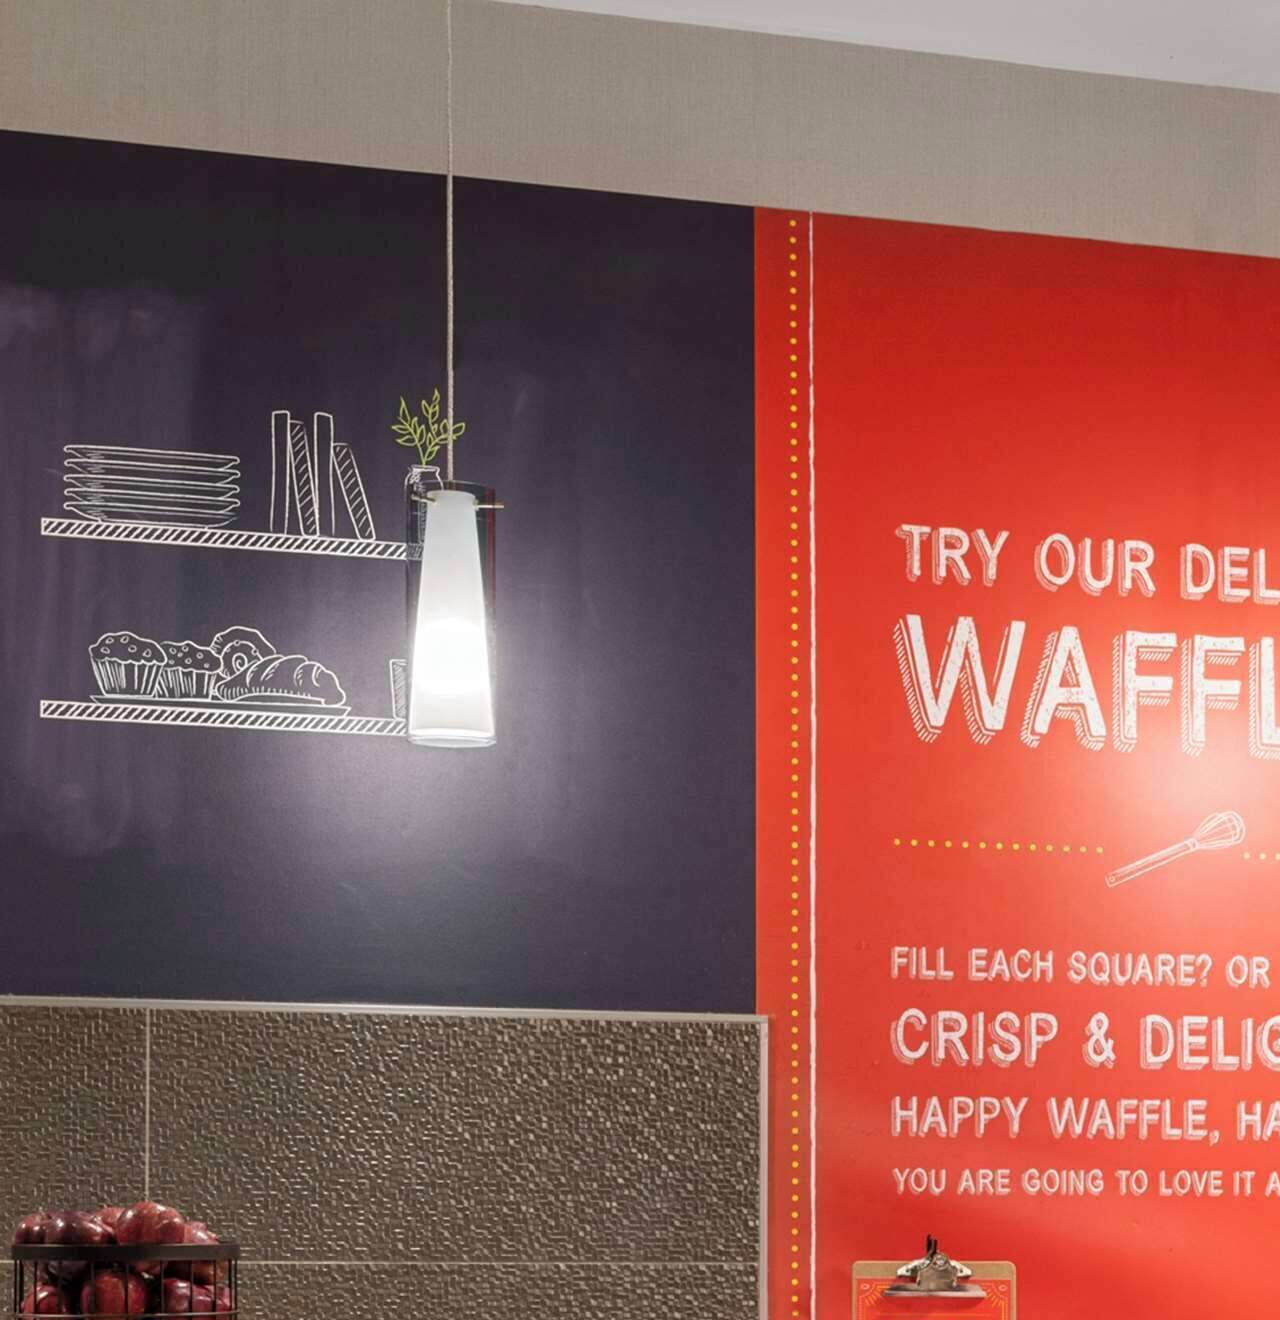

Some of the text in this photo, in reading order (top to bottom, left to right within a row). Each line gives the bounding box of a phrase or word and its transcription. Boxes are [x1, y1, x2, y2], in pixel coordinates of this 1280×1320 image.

[896, 523, 1010, 588] TRY
[1034, 533, 1157, 598] OUR
[891, 946, 955, 980] FILL
[968, 948, 1055, 982] EACH
[1067, 951, 1213, 987] SQUARE?
[1226, 954, 1271, 988] OR
[890, 1008, 1058, 1067] CRISP
[1082, 1011, 1116, 1069] &
[891, 1096, 1029, 1139] HAPPY
[1047, 1096, 1221, 1146] WAFFLE,
[893, 1167, 947, 1195] YOU
[957, 1168, 1011, 1195] ARE
[1022, 1168, 1105, 1196] GOING
[1115, 1169, 1149, 1196] TO
[1159, 1169, 1224, 1197] LOVE
[1233, 1170, 1256, 1197] IT
